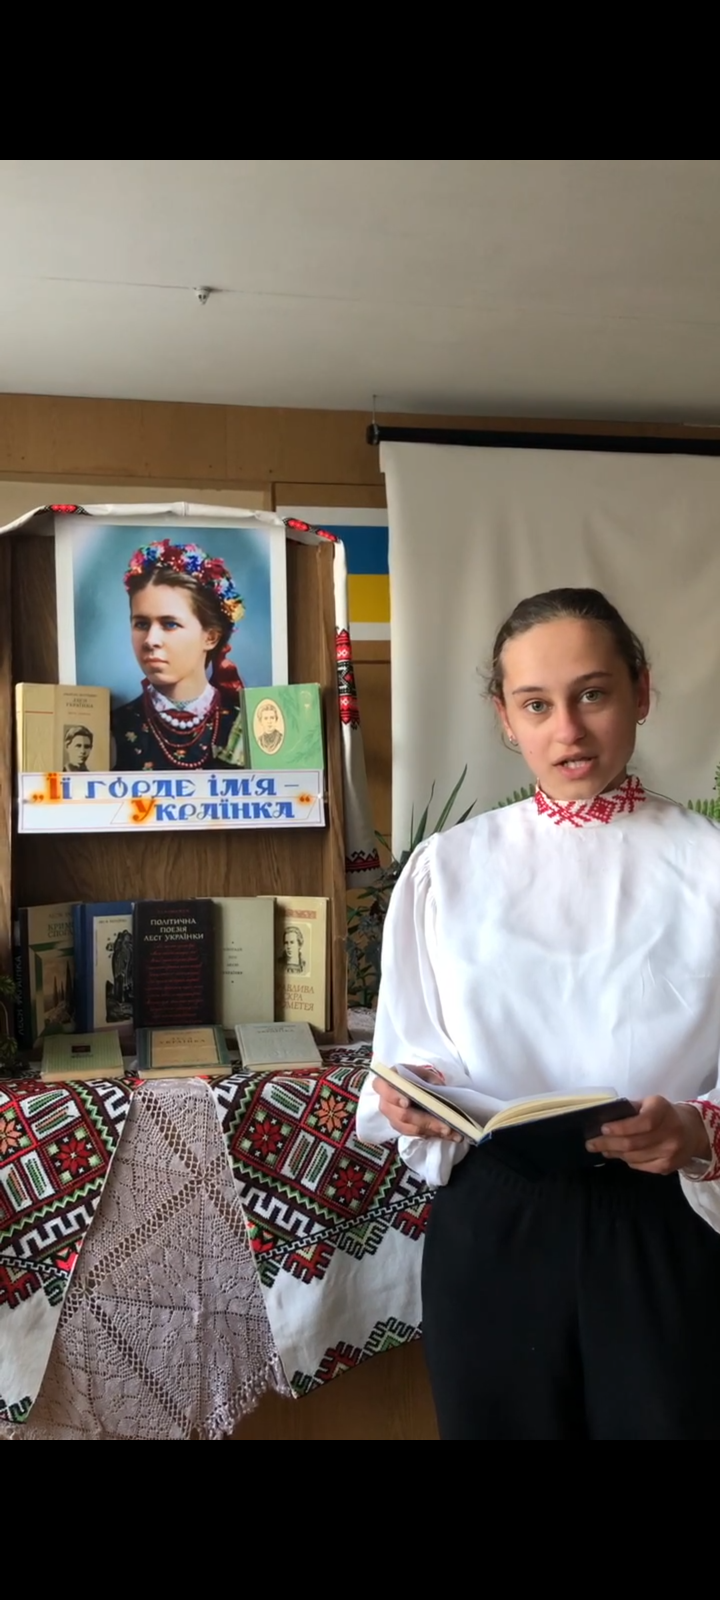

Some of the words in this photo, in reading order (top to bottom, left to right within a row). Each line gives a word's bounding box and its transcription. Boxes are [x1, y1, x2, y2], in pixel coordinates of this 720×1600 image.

[150, 917, 197, 926] ПОЛІТИЧНА
[160, 925, 187, 934] ПОЕЗІЯ
[164, 932, 204, 942] УКРАЇНКИ
